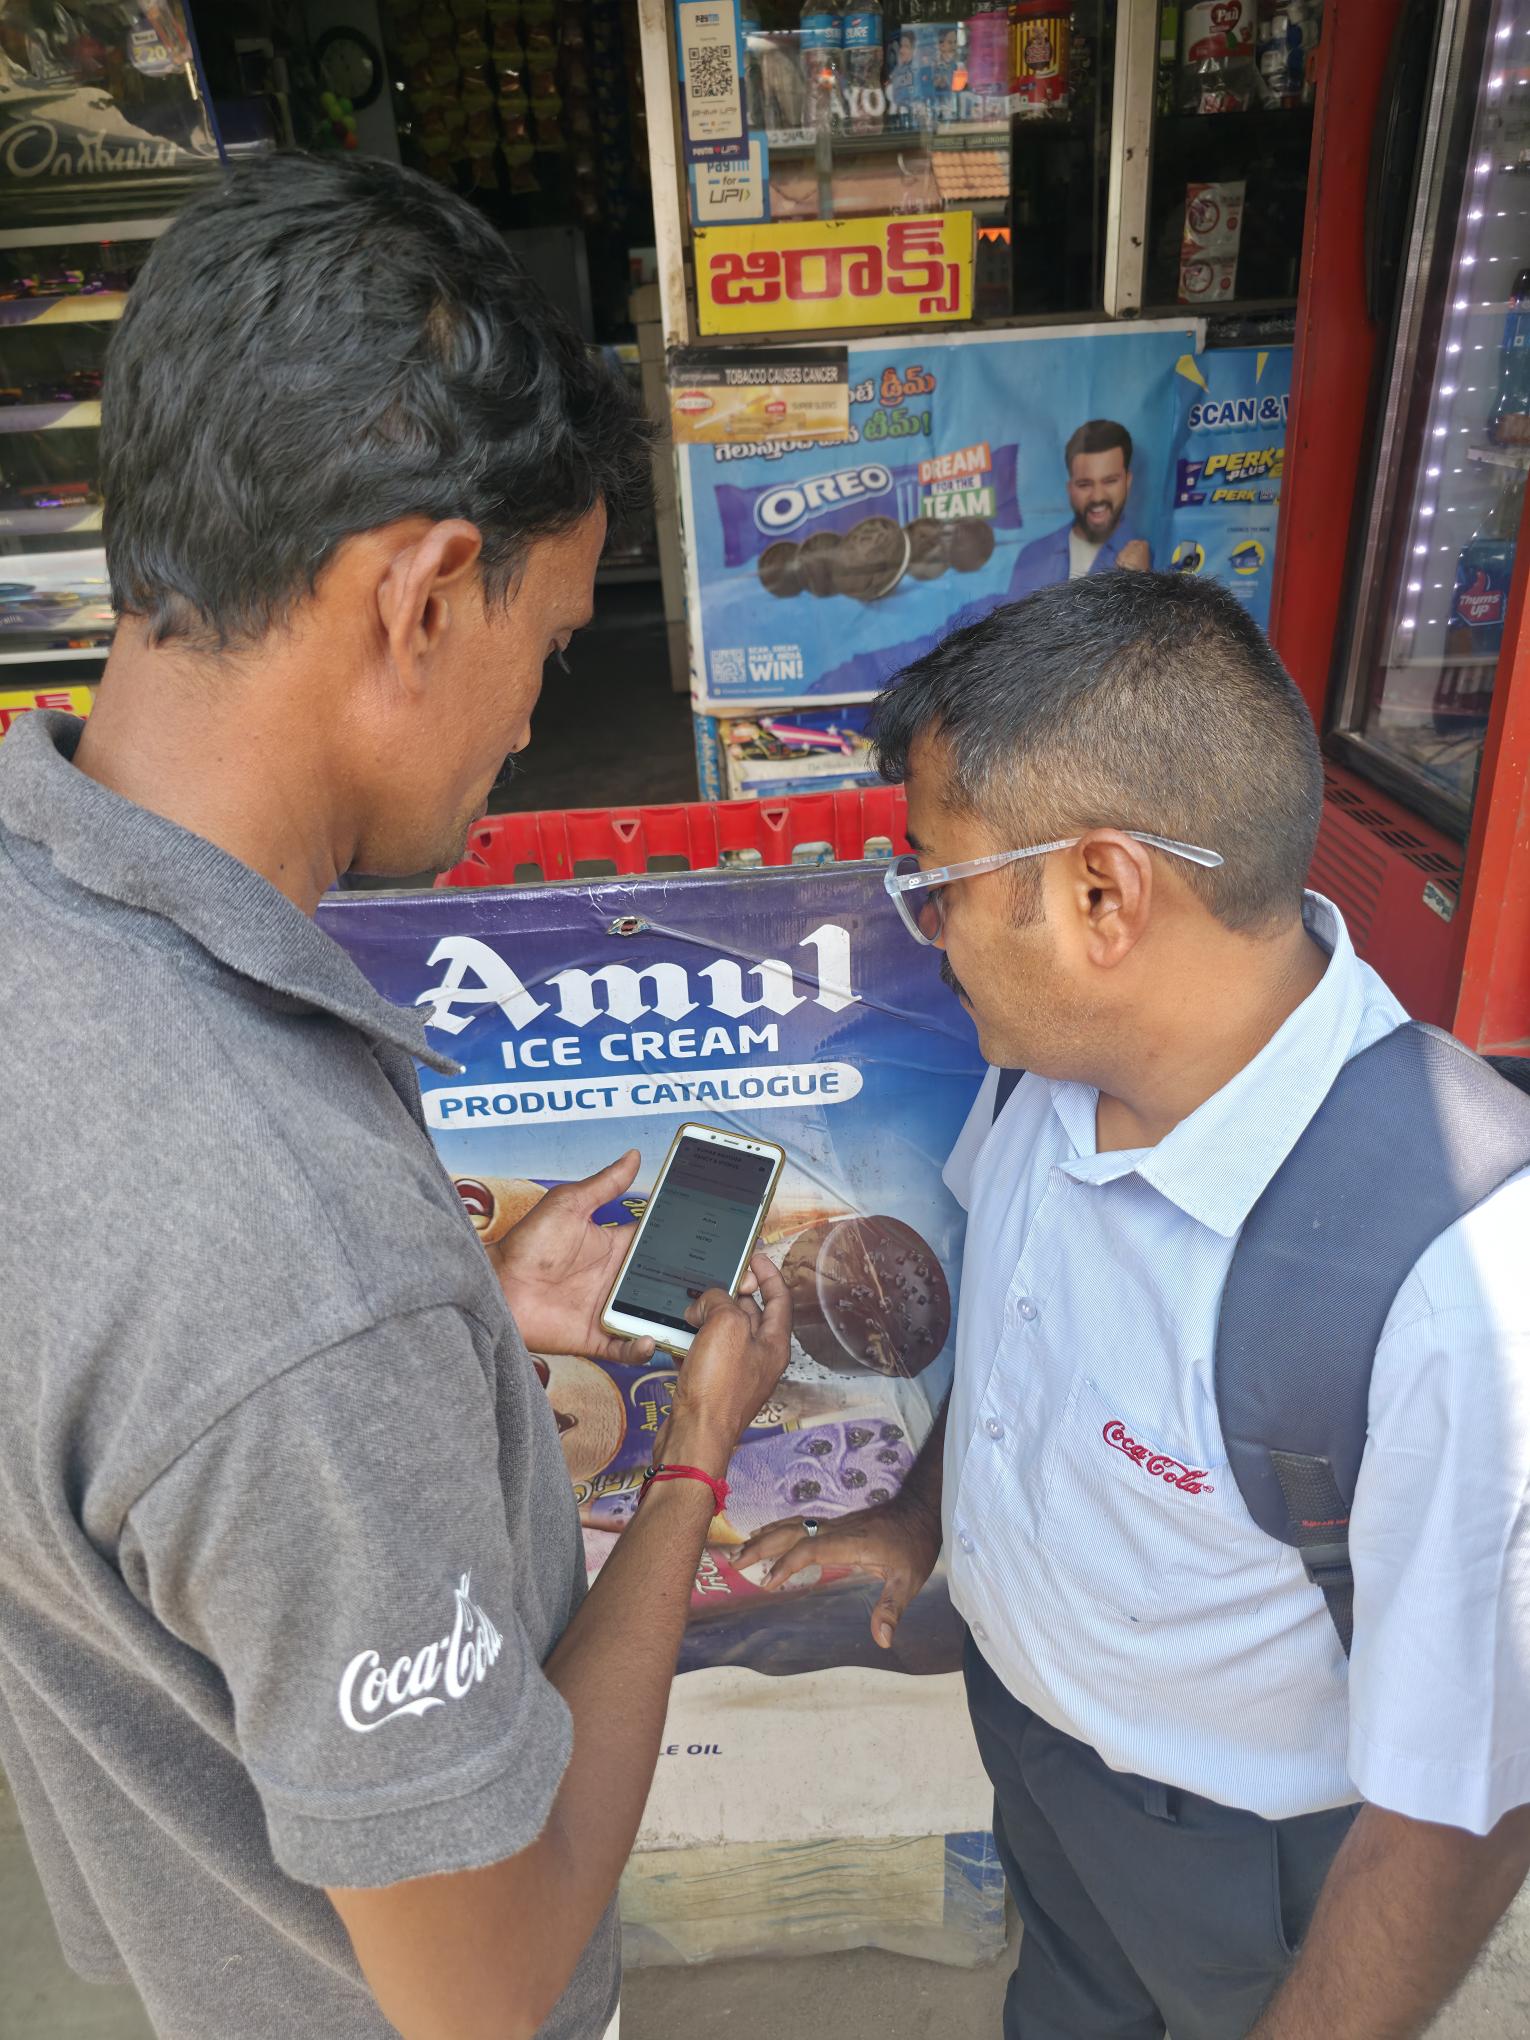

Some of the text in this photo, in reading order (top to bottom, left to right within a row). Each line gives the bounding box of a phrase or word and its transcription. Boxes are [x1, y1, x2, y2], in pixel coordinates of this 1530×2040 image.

[723, 176, 737, 186] for
[709, 188, 745, 204] UPI
[709, 219, 960, 315] జిరాక్స్
[724, 368, 767, 385] TOBACCO
[767, 367, 802, 383] CAUSES
[803, 366, 839, 382] CANCER
[1188, 399, 1256, 430] SCAN
[1259, 396, 1280, 421] &
[922, 446, 987, 481] DREAM
[1204, 447, 1276, 476] PERK
[1228, 465, 1265, 481] PLUS
[760, 466, 889, 527] OREO
[935, 477, 975, 492] FOR THE
[1211, 488, 1255, 502] PERK
[923, 489, 992, 518] TEAM
[1460, 594, 1499, 605] Thums
[748, 660, 804, 682] WIN!
[415, 924, 863, 1036] Amul
[502, 1023, 780, 1070] ICE CREAM
[439, 1072, 841, 1121] PRODUCT CATALOGUE
[640, 1401, 658, 1432] Amul
[687, 1744, 723, 1755] OIL
